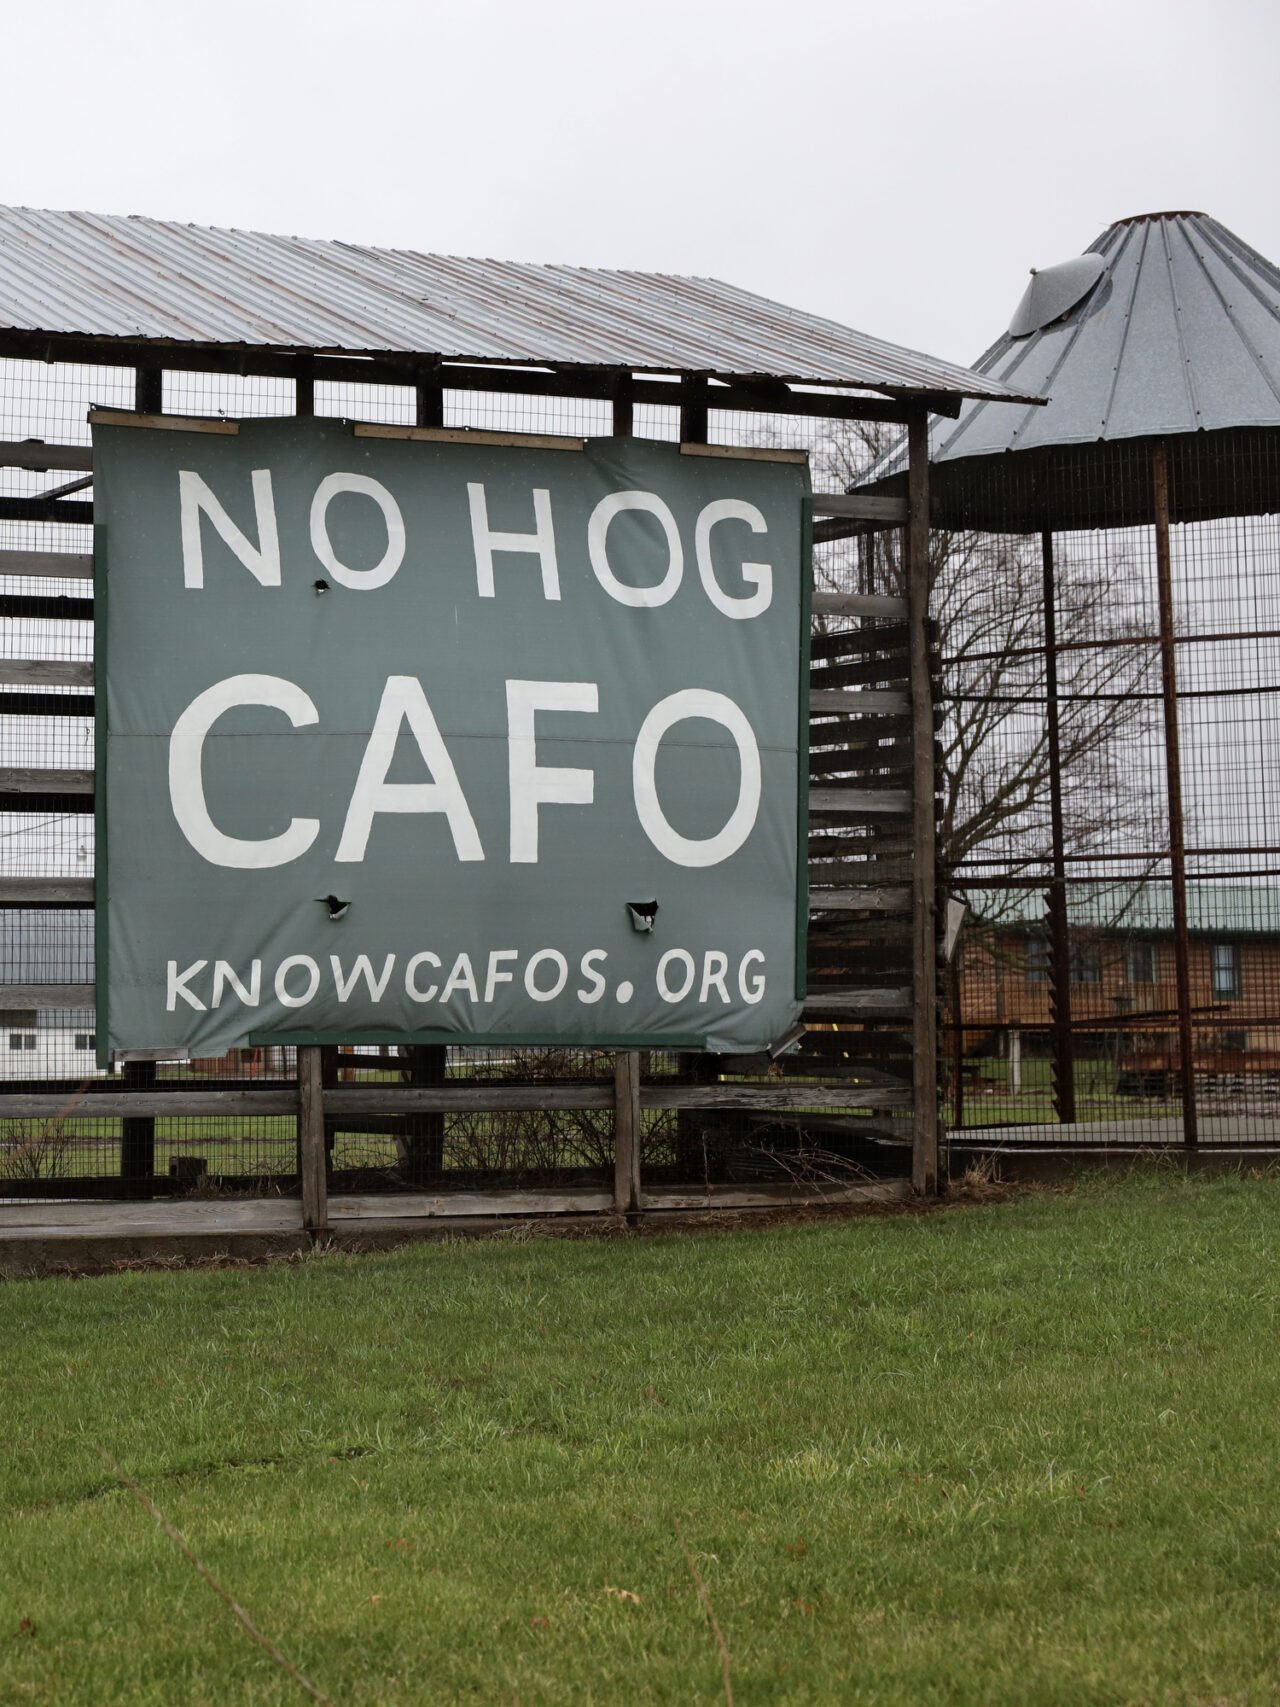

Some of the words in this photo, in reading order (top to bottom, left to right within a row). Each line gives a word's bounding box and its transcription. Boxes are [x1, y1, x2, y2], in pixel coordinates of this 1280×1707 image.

[179, 470, 405, 590] NO
[467, 483, 772, 619] HOG
[169, 674, 761, 868] CAFO
